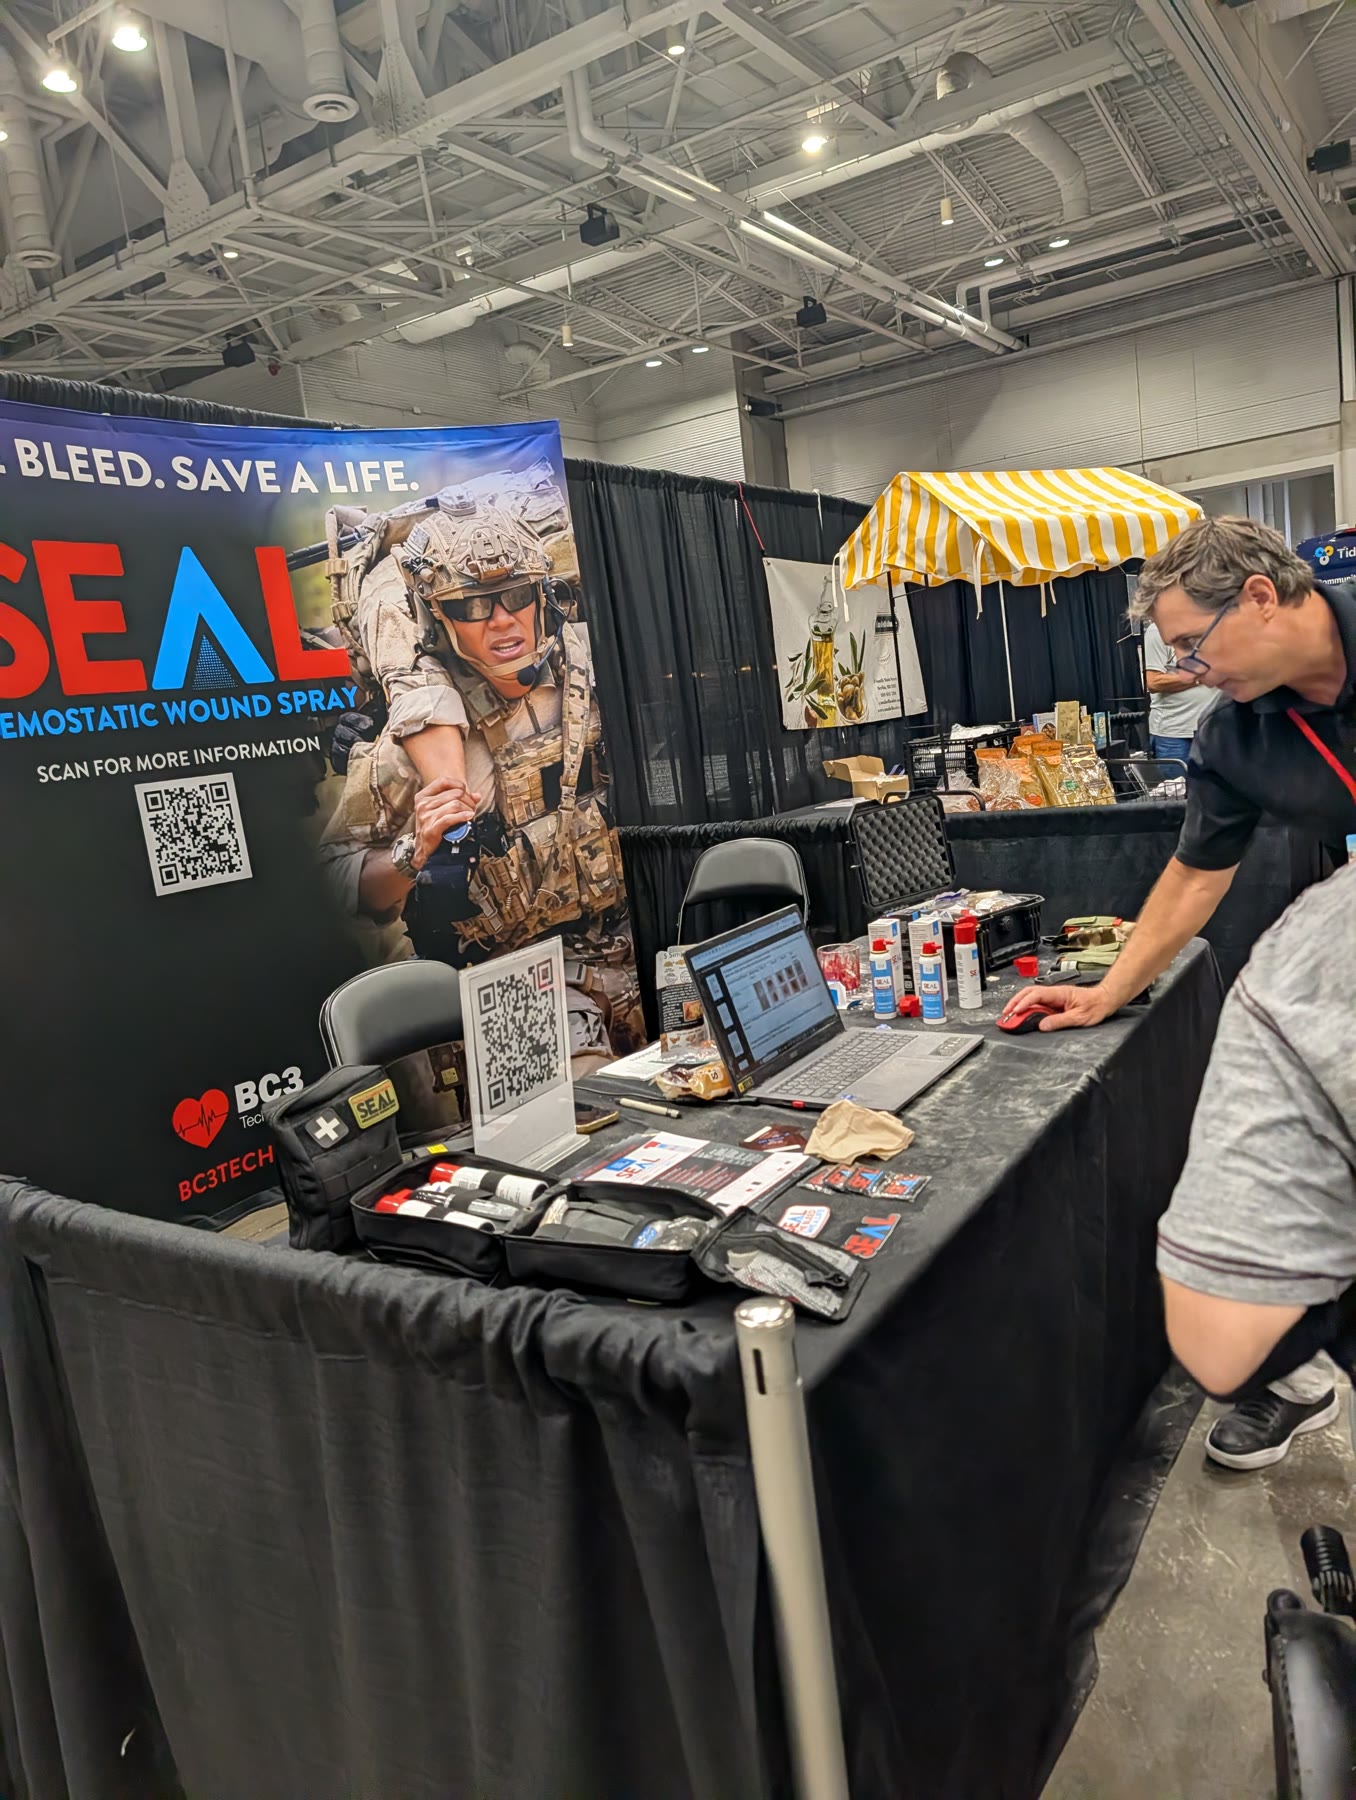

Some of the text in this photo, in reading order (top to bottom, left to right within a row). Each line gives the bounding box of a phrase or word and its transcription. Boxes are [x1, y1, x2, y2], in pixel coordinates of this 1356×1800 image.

[14, 438, 419, 493] BLEED. SAVE A LIFE.
[162, 694, 272, 725] WOUND
[279, 685, 358, 715] SPRAY
[37, 736, 321, 783] SCAN FOR MORE INFORMATION
[234, 1066, 304, 1113] BC3
[355, 1089, 397, 1120] SEAL
[239, 1113, 265, 1129] Tec
[178, 1145, 274, 1201] BC3TECH
[616, 1158, 661, 1178] SEAL
[843, 1213, 898, 1258] SEAL
